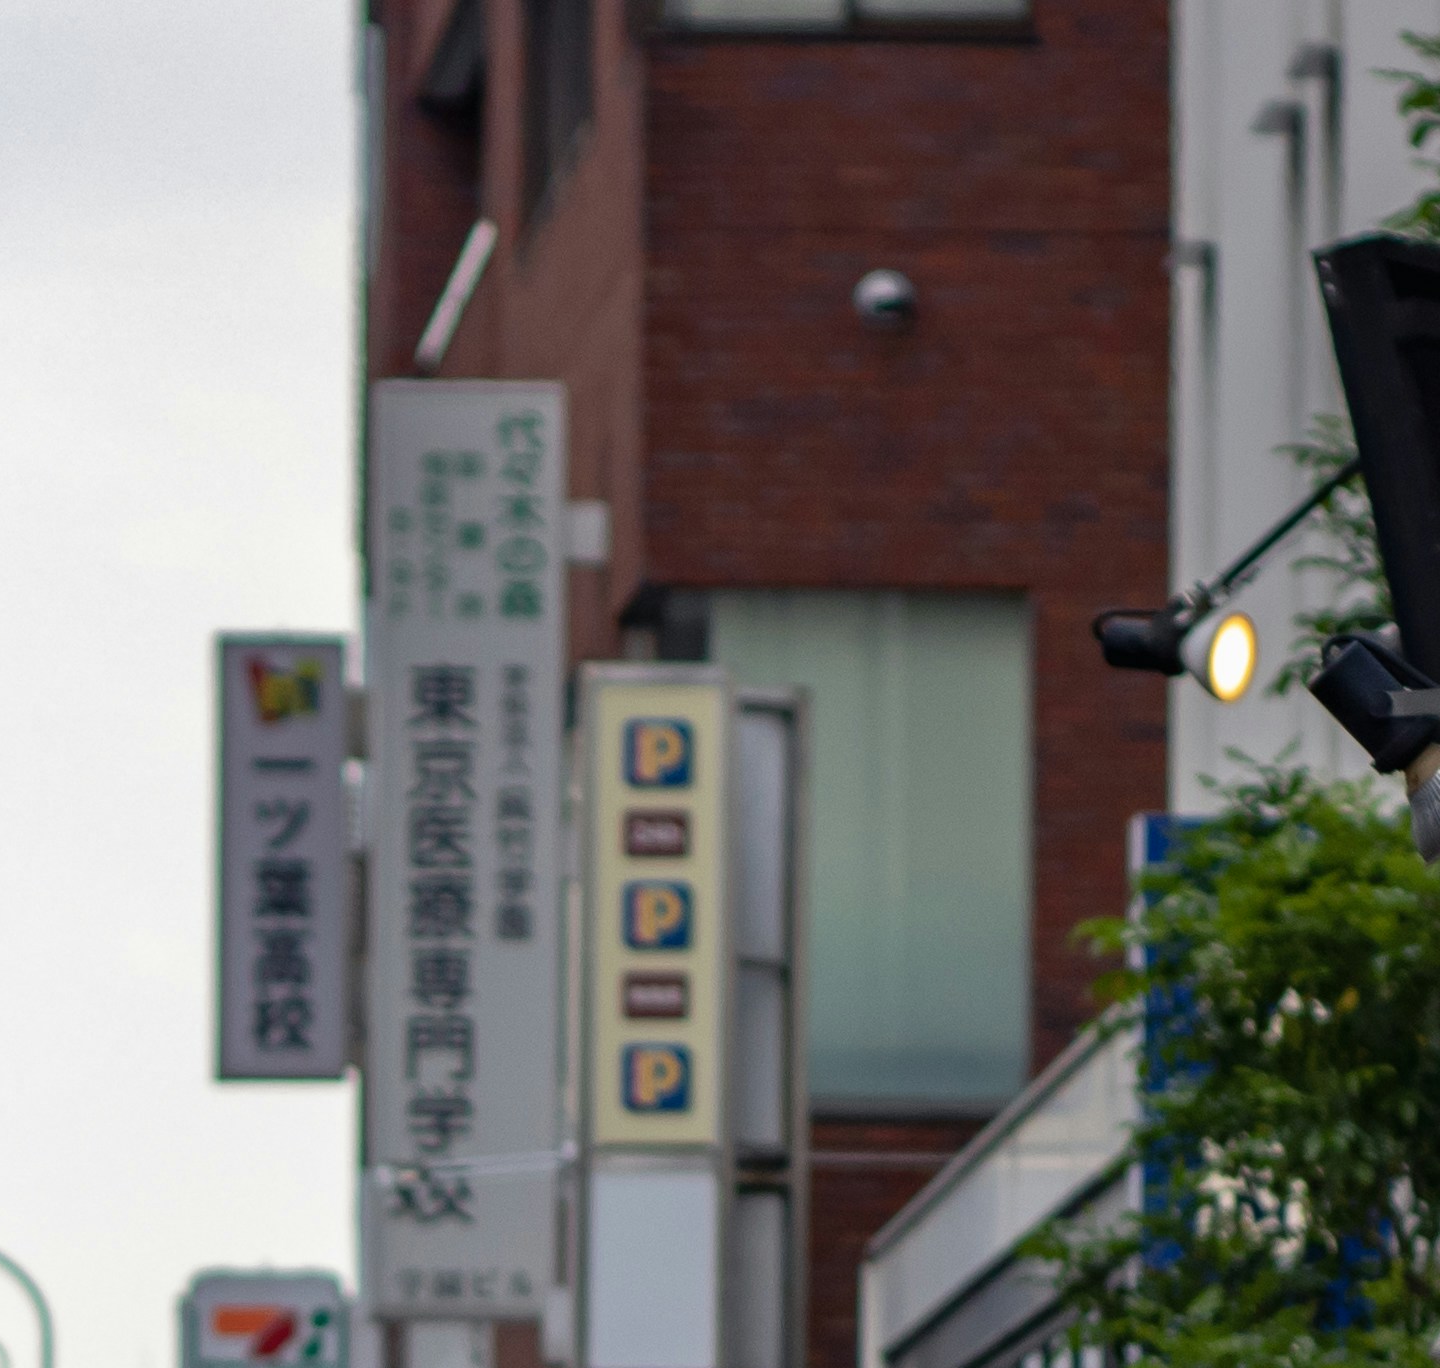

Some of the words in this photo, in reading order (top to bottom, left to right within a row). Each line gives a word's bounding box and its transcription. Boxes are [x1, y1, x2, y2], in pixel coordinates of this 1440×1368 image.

[634, 724, 684, 781] P
[252, 755, 317, 1051] 一ツ葉高校
[634, 886, 684, 943] P
[392, 663, 480, 1224] 東京医療専門学校
[634, 1048, 682, 1105] P
